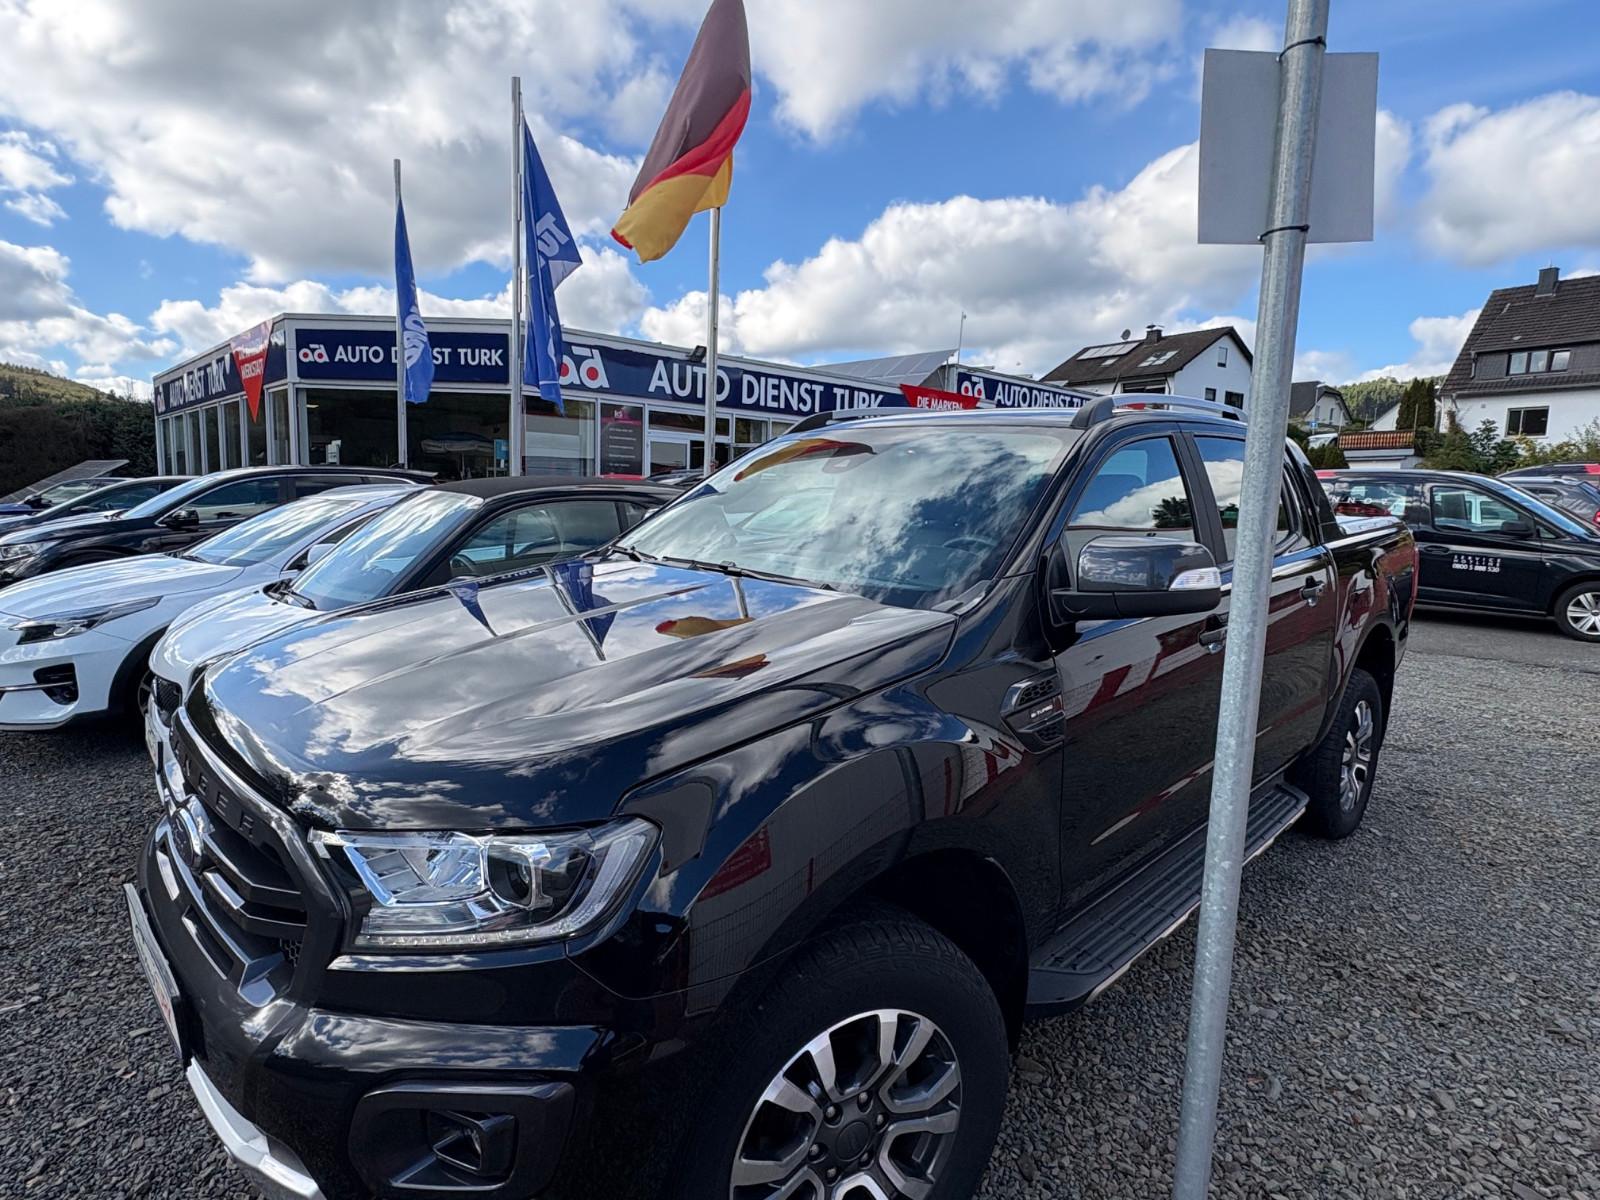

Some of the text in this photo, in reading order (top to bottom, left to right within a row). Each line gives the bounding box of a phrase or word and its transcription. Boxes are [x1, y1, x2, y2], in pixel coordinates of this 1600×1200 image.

[334, 345, 384, 364] AUTO
[391, 346, 451, 366] DST
[458, 348, 504, 367] TURK
[648, 359, 730, 401] AUTO
[741, 374, 825, 414] DIENST
[833, 387, 885, 412] TURK
[994, 382, 1031, 408] AUTO
[1031, 387, 1071, 409] DIENST
[917, 395, 963, 411] DIE MARKEN
